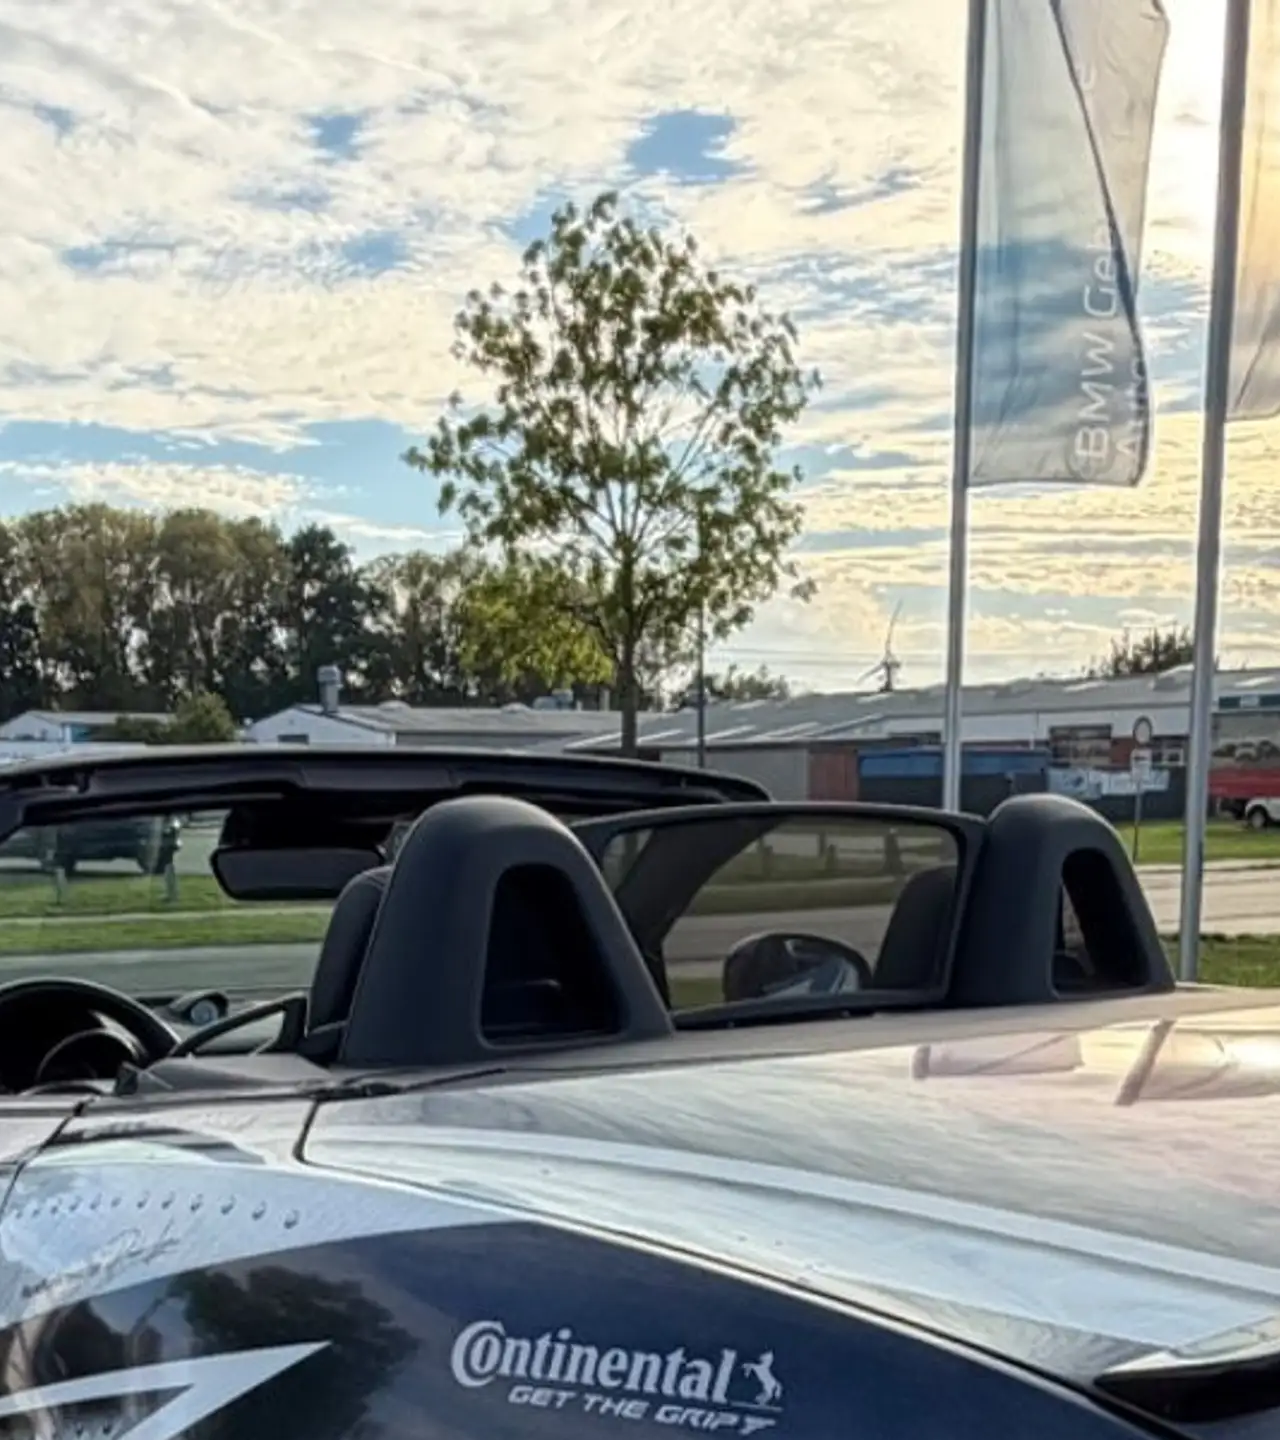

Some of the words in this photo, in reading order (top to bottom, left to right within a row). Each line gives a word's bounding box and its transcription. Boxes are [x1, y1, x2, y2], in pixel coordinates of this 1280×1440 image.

[1075, 331, 1114, 459] BMW
[450, 1320, 737, 1404] Continental
[508, 1384, 575, 1411] GET
[583, 1393, 650, 1420] THE
[654, 1403, 740, 1433] GRIP
